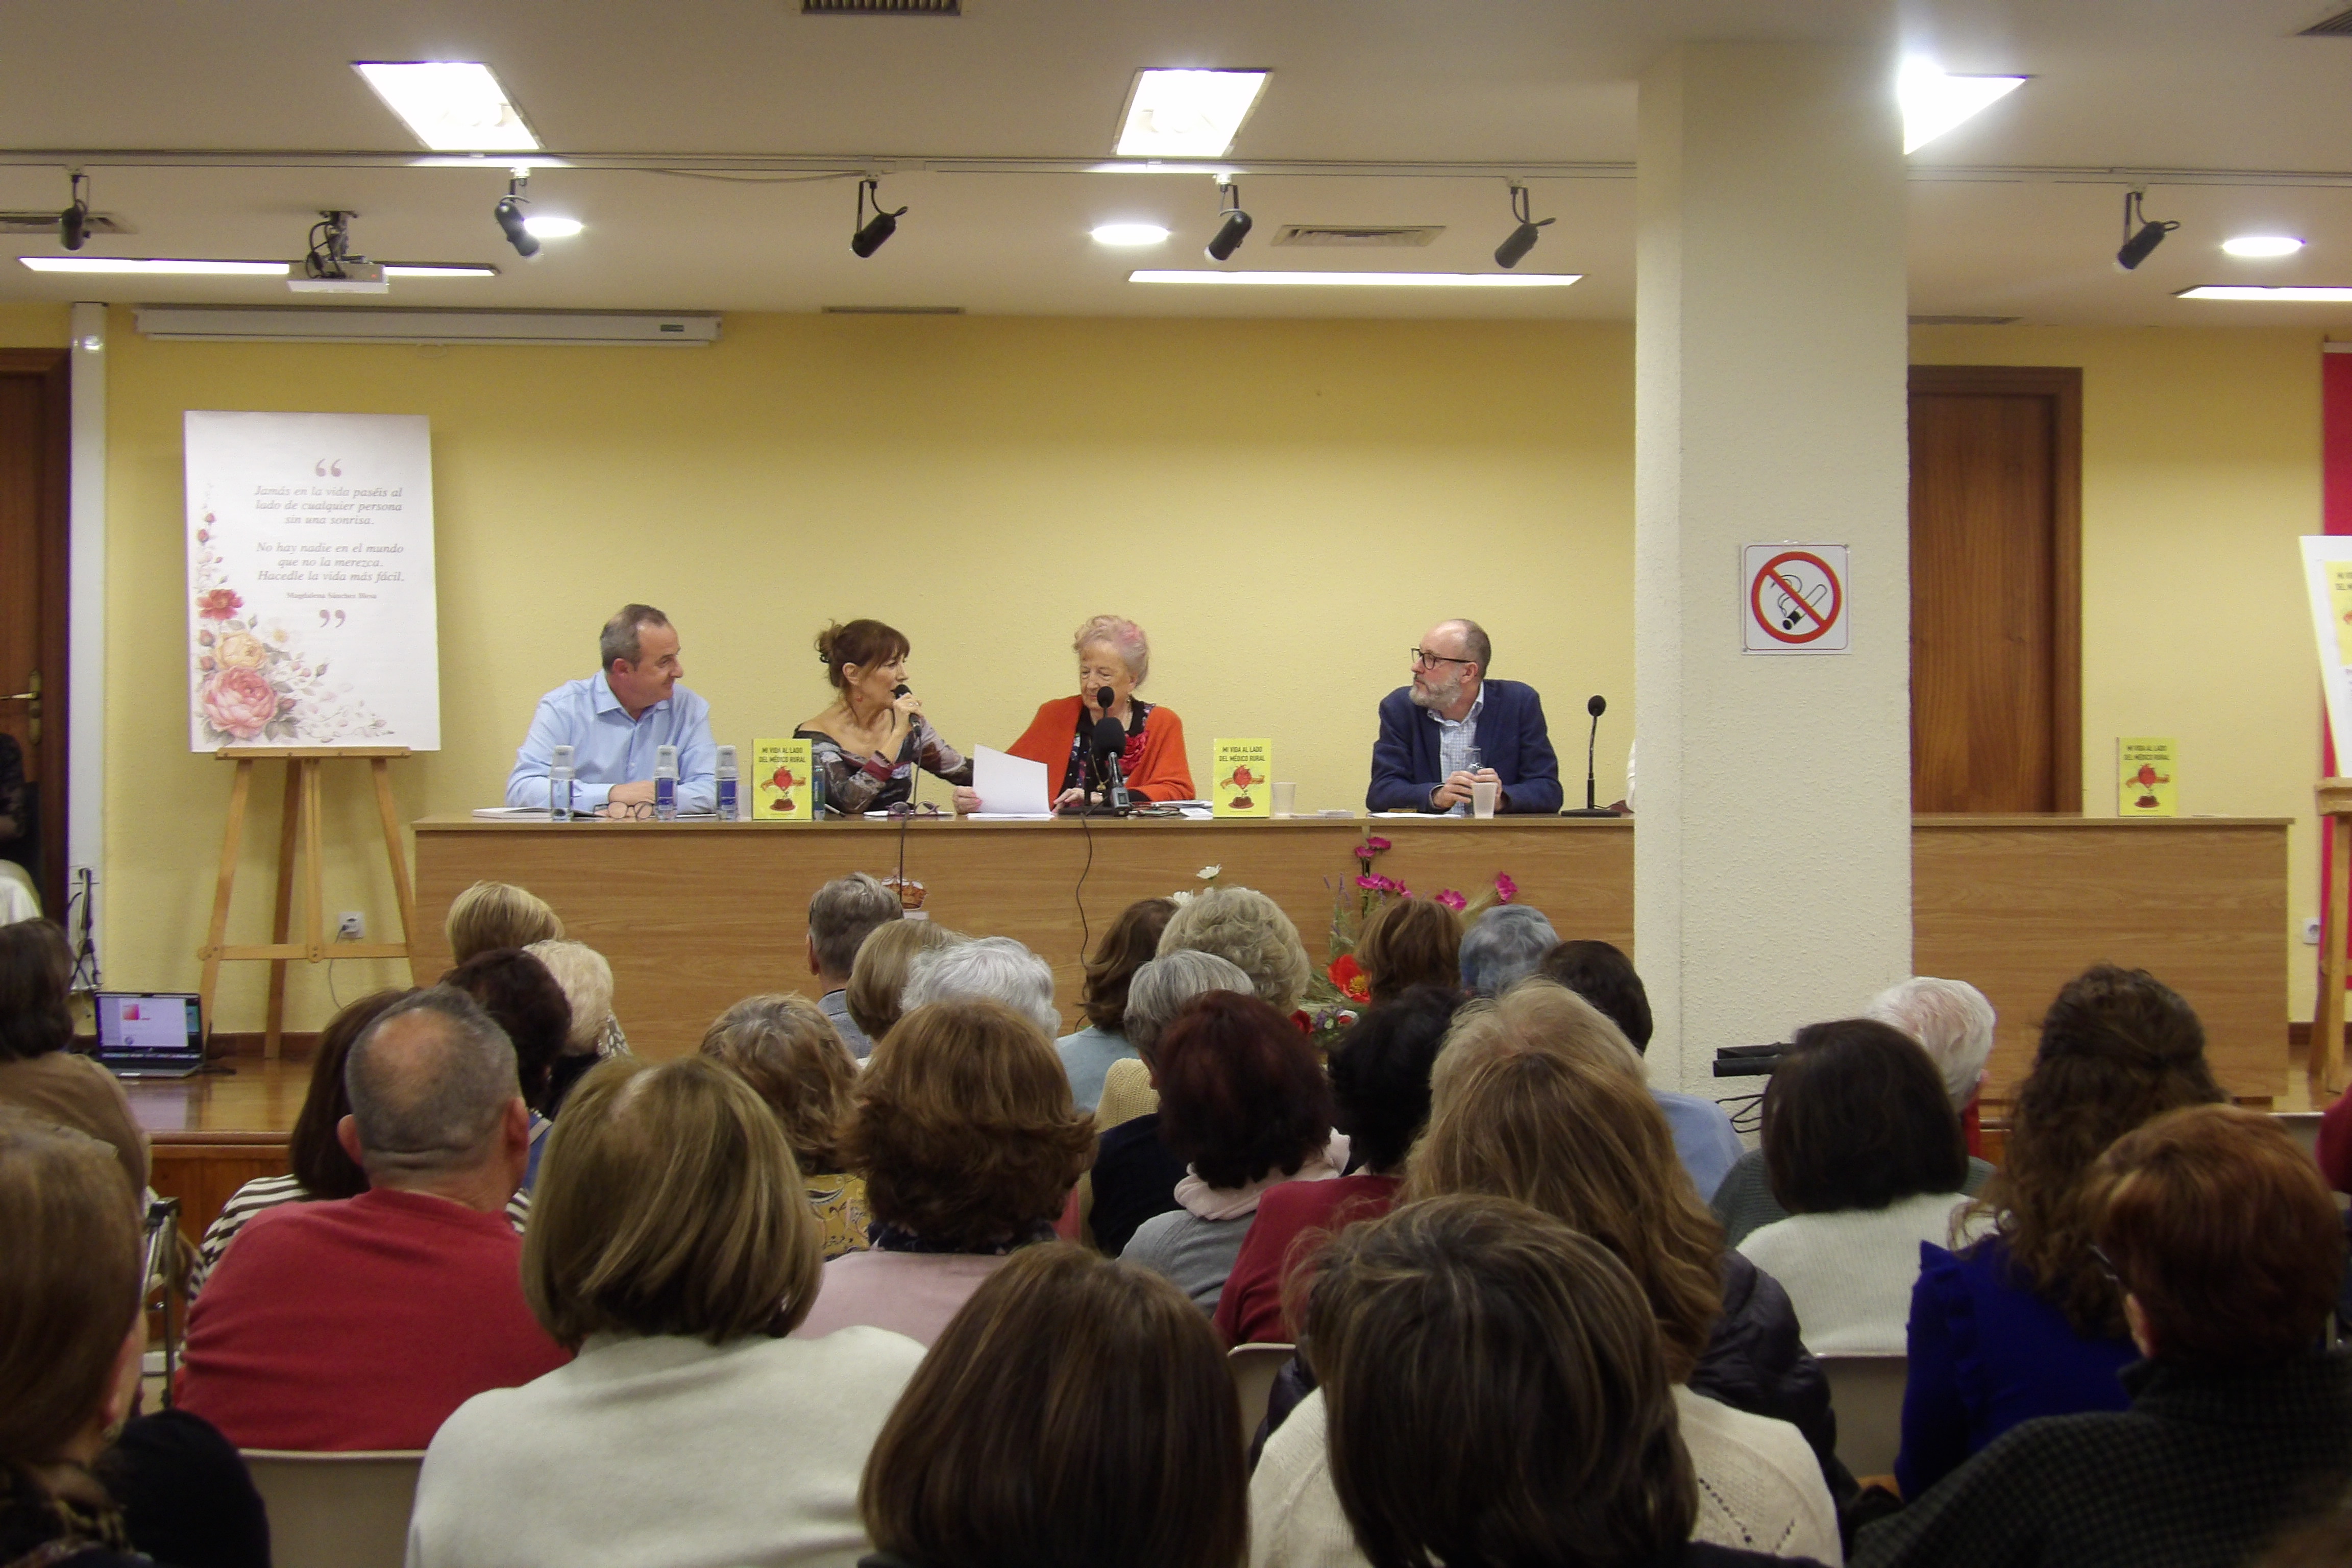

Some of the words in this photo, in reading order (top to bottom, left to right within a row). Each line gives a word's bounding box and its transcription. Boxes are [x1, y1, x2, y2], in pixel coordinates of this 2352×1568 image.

[254, 485, 290, 496] Jamás
[311, 486, 323, 496] la
[326, 486, 350, 496] vida
[353, 487, 387, 498] paséis
[391, 487, 403, 497] al
[255, 499, 281, 509] lado
[284, 500, 298, 509] de
[301, 500, 355, 512] cualquier
[358, 503, 402, 512] persona
[285, 514, 301, 524] sin
[331, 515, 374, 524] sonrisa.
[256, 543, 273, 552] No
[275, 543, 297, 554] hay
[301, 543, 332, 552] nadie
[353, 543, 362, 553] el
[365, 544, 404, 553] mundo
[278, 559, 298, 569] que
[320, 557, 331, 566] la
[334, 559, 383, 568] merezca.
[258, 571, 304, 580] Hacedle
[308, 571, 319, 580] la
[323, 571, 346, 581] vida
[350, 571, 373, 581] más
[374, 571, 404, 583] fácil.
